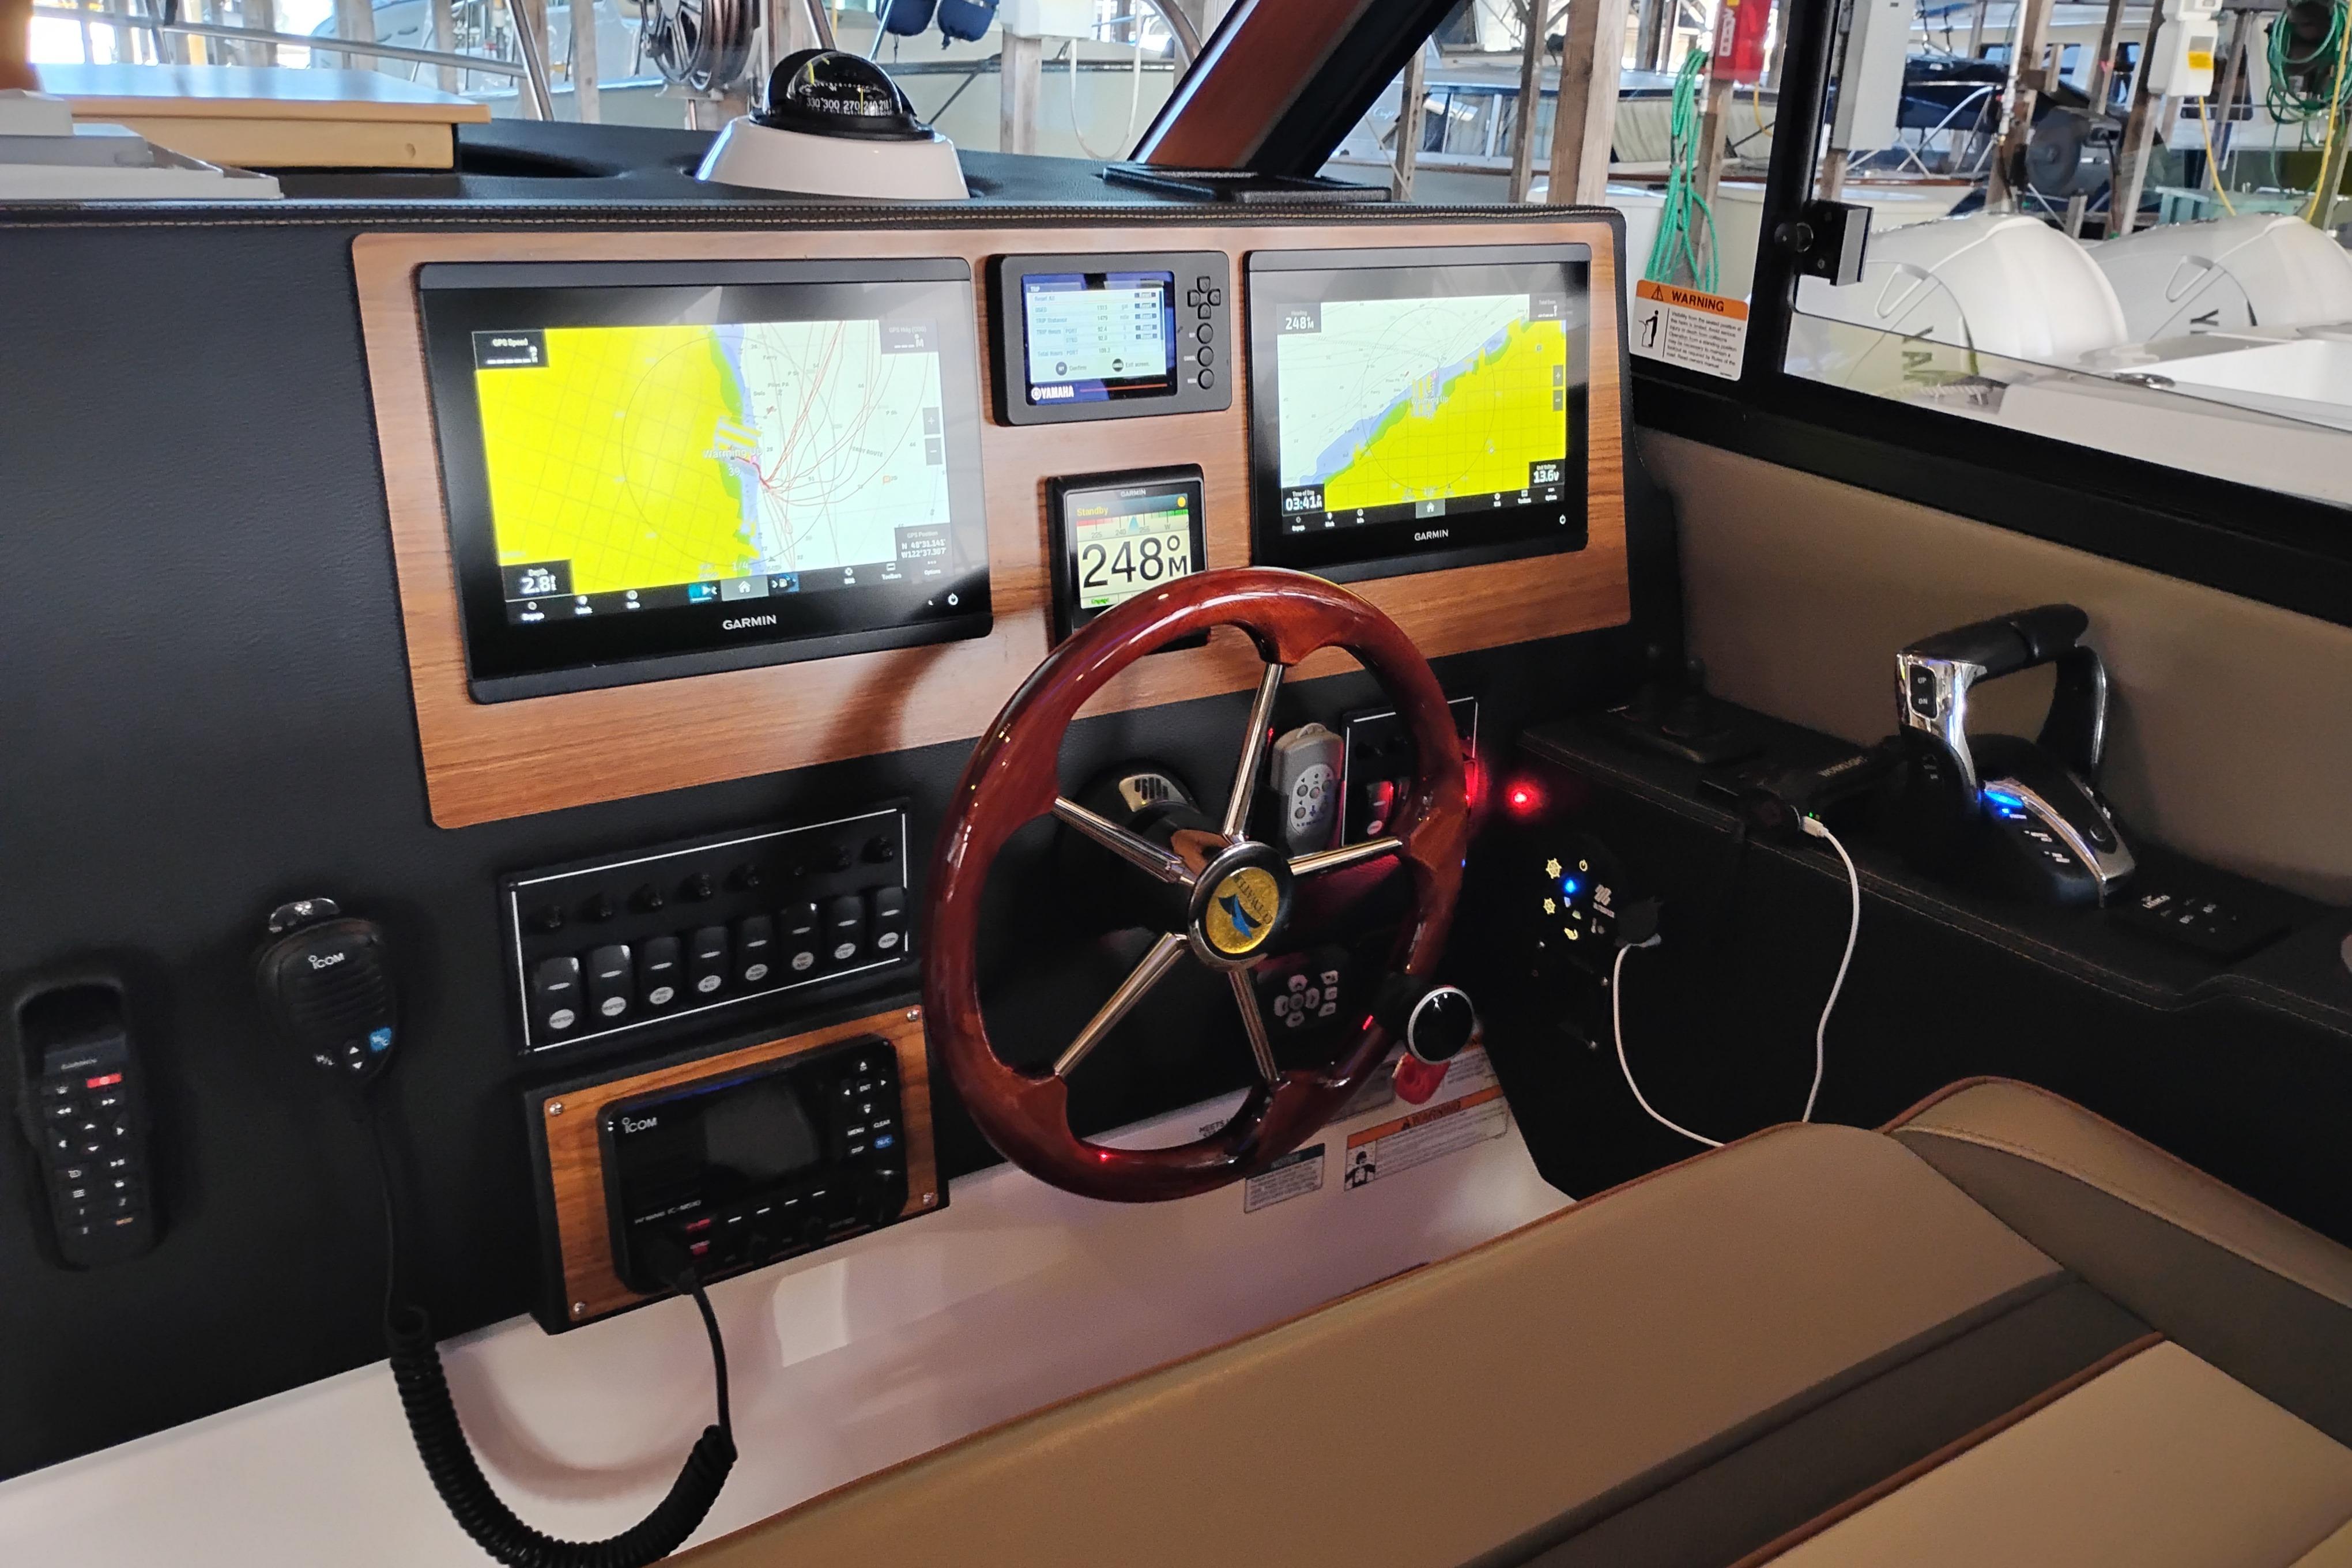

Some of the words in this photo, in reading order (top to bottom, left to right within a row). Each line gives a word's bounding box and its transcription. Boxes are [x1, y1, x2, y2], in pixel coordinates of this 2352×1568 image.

[807, 97, 820, 108] 330
[823, 99, 839, 110] 300
[843, 100, 860, 111] 270
[1672, 290, 1724, 312] WARNING
[1041, 385, 1075, 399] YAMAHA
[702, 447, 747, 459] Warming
[751, 447, 763, 459] Up
[728, 466, 741, 477] 39
[1120, 488, 1147, 497] GARMIN
[1076, 506, 1109, 517] Standby
[1414, 528, 1449, 541] GARMIN
[901, 542, 908, 551] N
[722, 614, 778, 630] GARMIN
